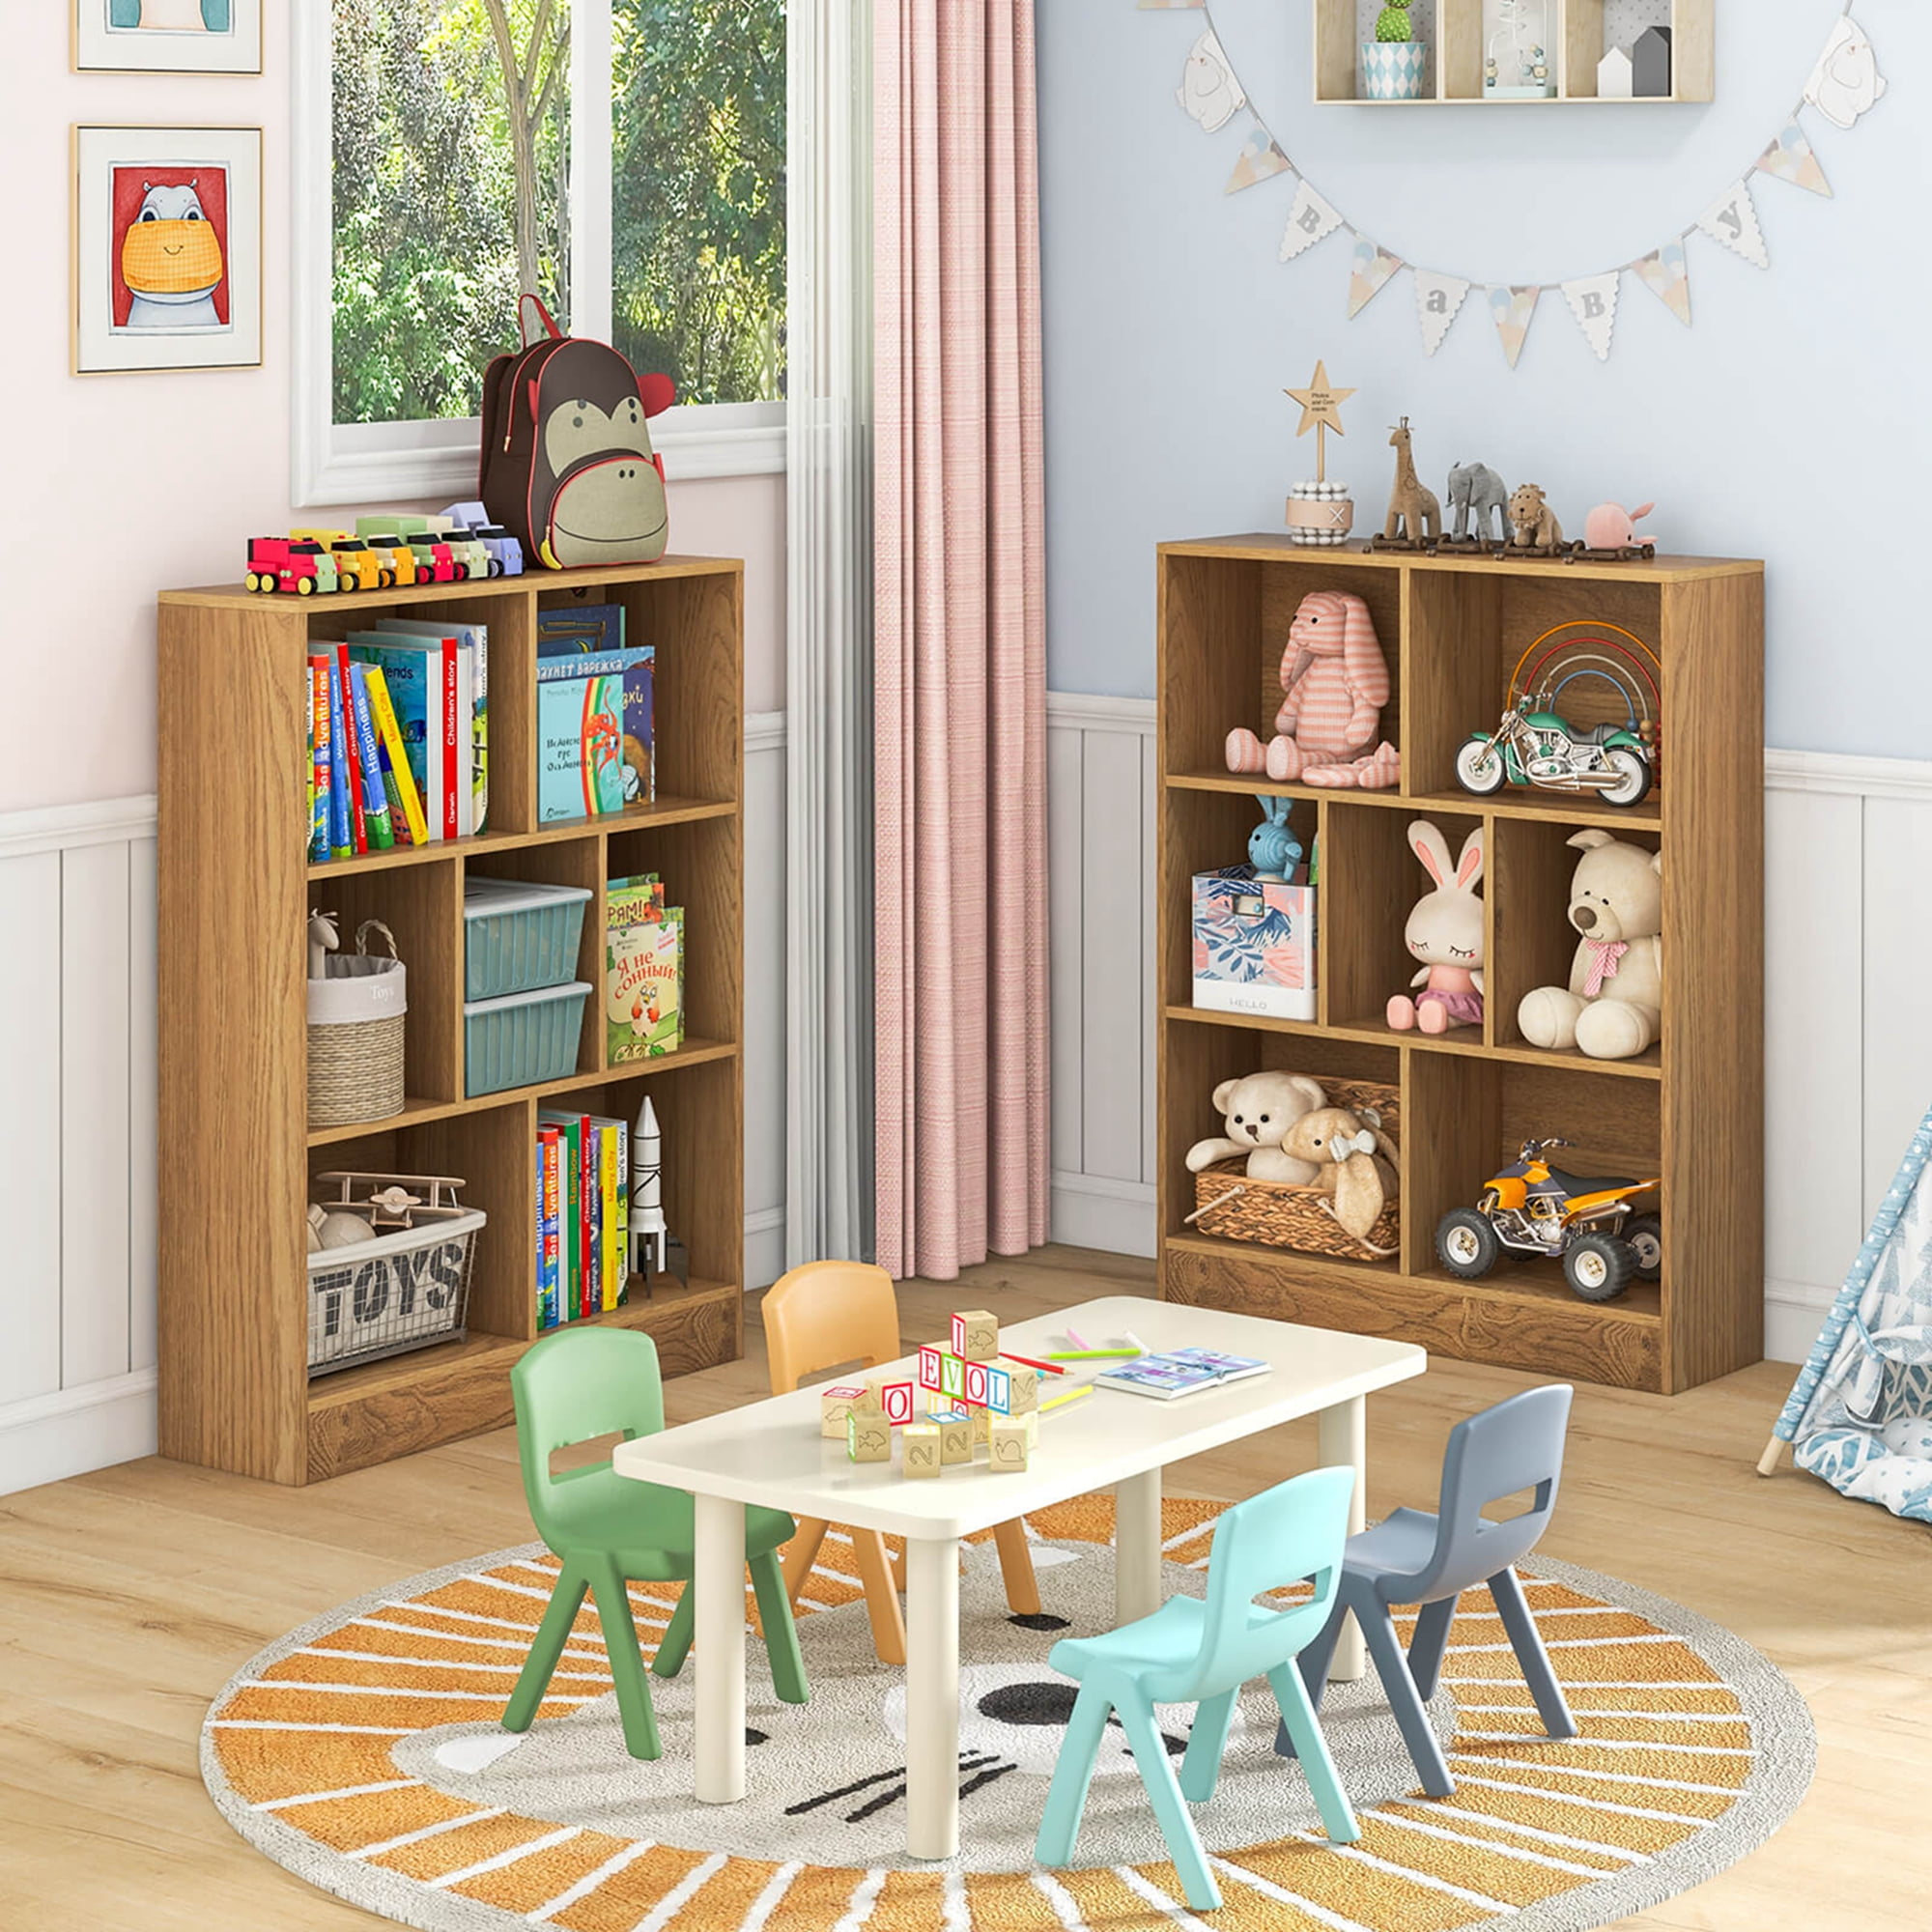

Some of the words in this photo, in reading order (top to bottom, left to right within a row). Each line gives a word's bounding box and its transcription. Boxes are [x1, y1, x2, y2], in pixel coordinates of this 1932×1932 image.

[386, 665, 414, 679] ends
[447, 659, 457, 687] story
[320, 670, 329, 760] adventures
[446, 690, 455, 747] Children's
[357, 696, 378, 774] Happiness
[319, 763, 329, 796] Sea
[616, 956, 630, 980] Я
[1229, 997, 1267, 1009] HELLO
[549, 1145, 557, 1230] adventures
[548, 1235, 557, 1264] Sea
[313, 1242, 464, 1337] TOYS
